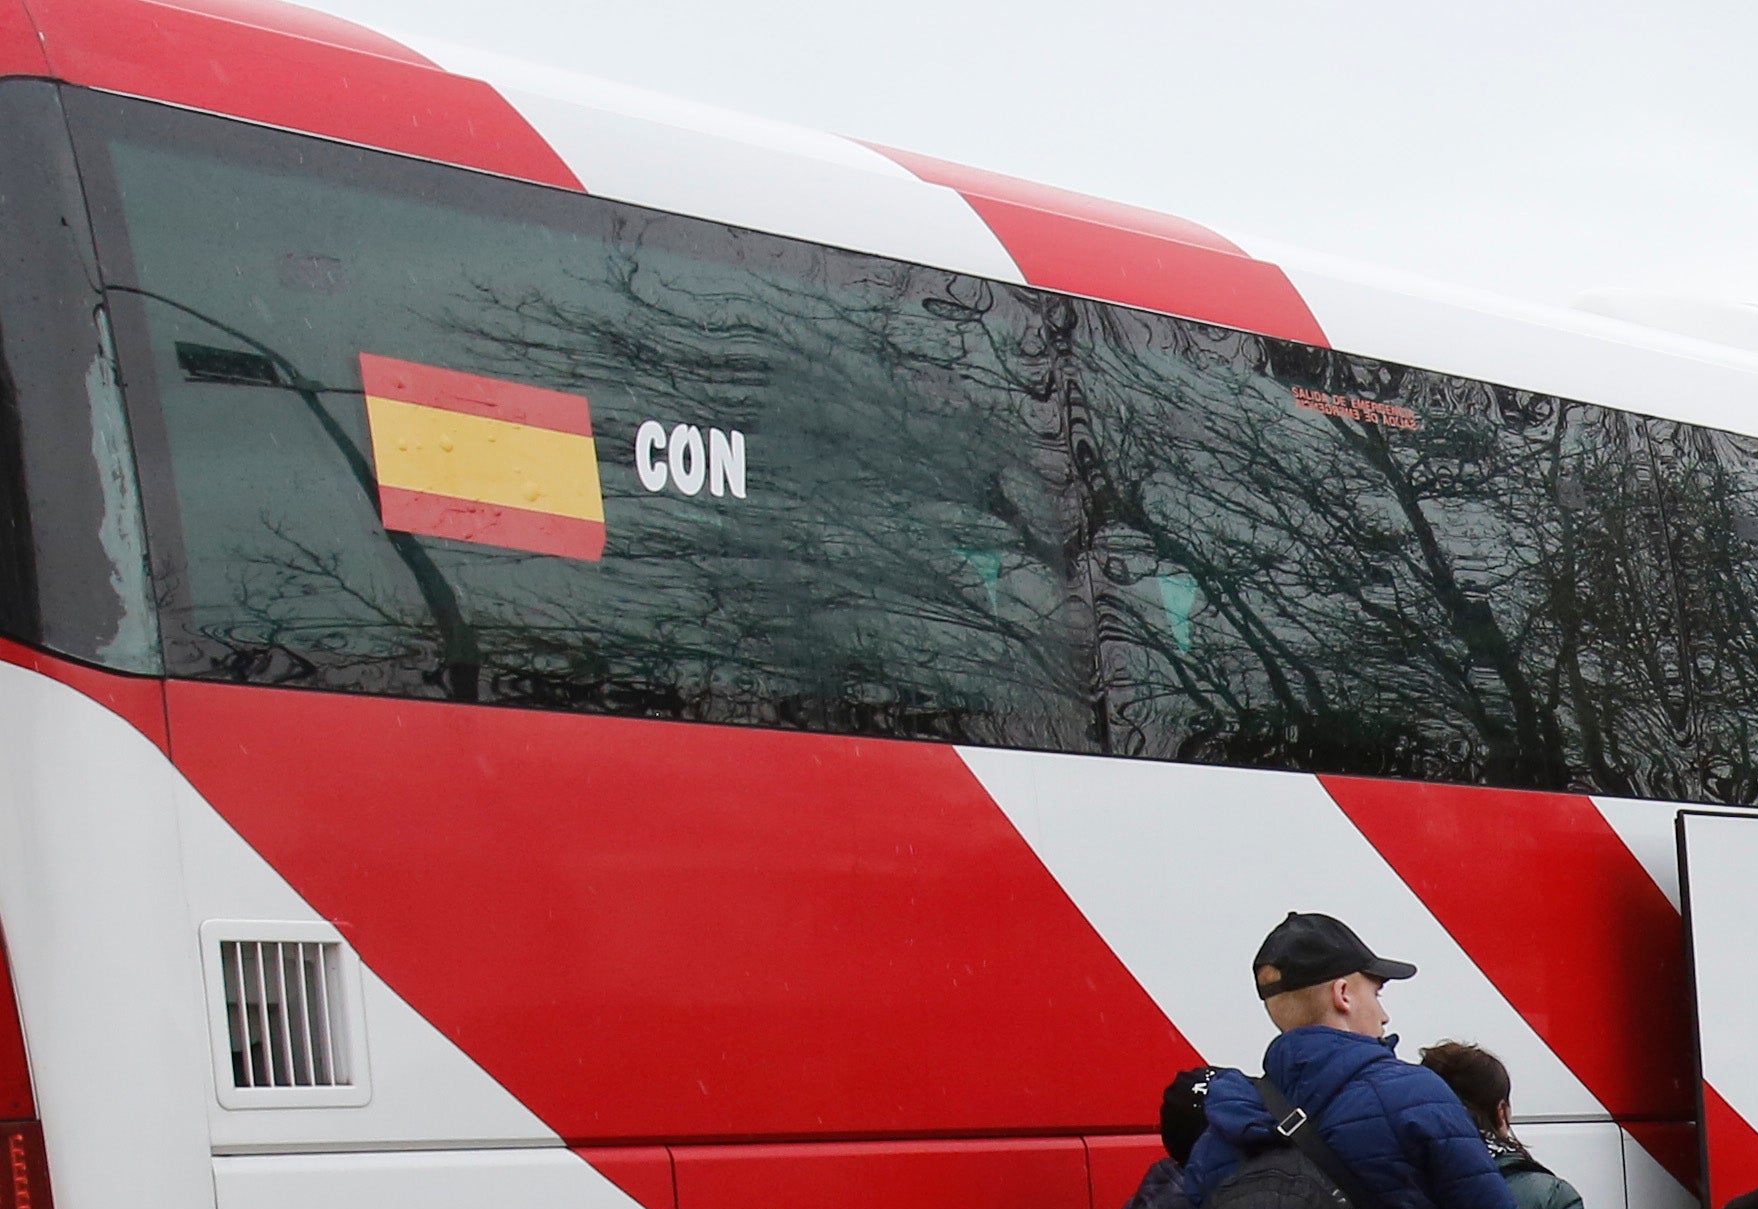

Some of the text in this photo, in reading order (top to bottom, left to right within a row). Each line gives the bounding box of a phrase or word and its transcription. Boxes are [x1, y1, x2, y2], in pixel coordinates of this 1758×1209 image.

[1290, 385, 1330, 403] SALIDA
[1332, 393, 1347, 407] DE
[635, 419, 747, 499] CON
